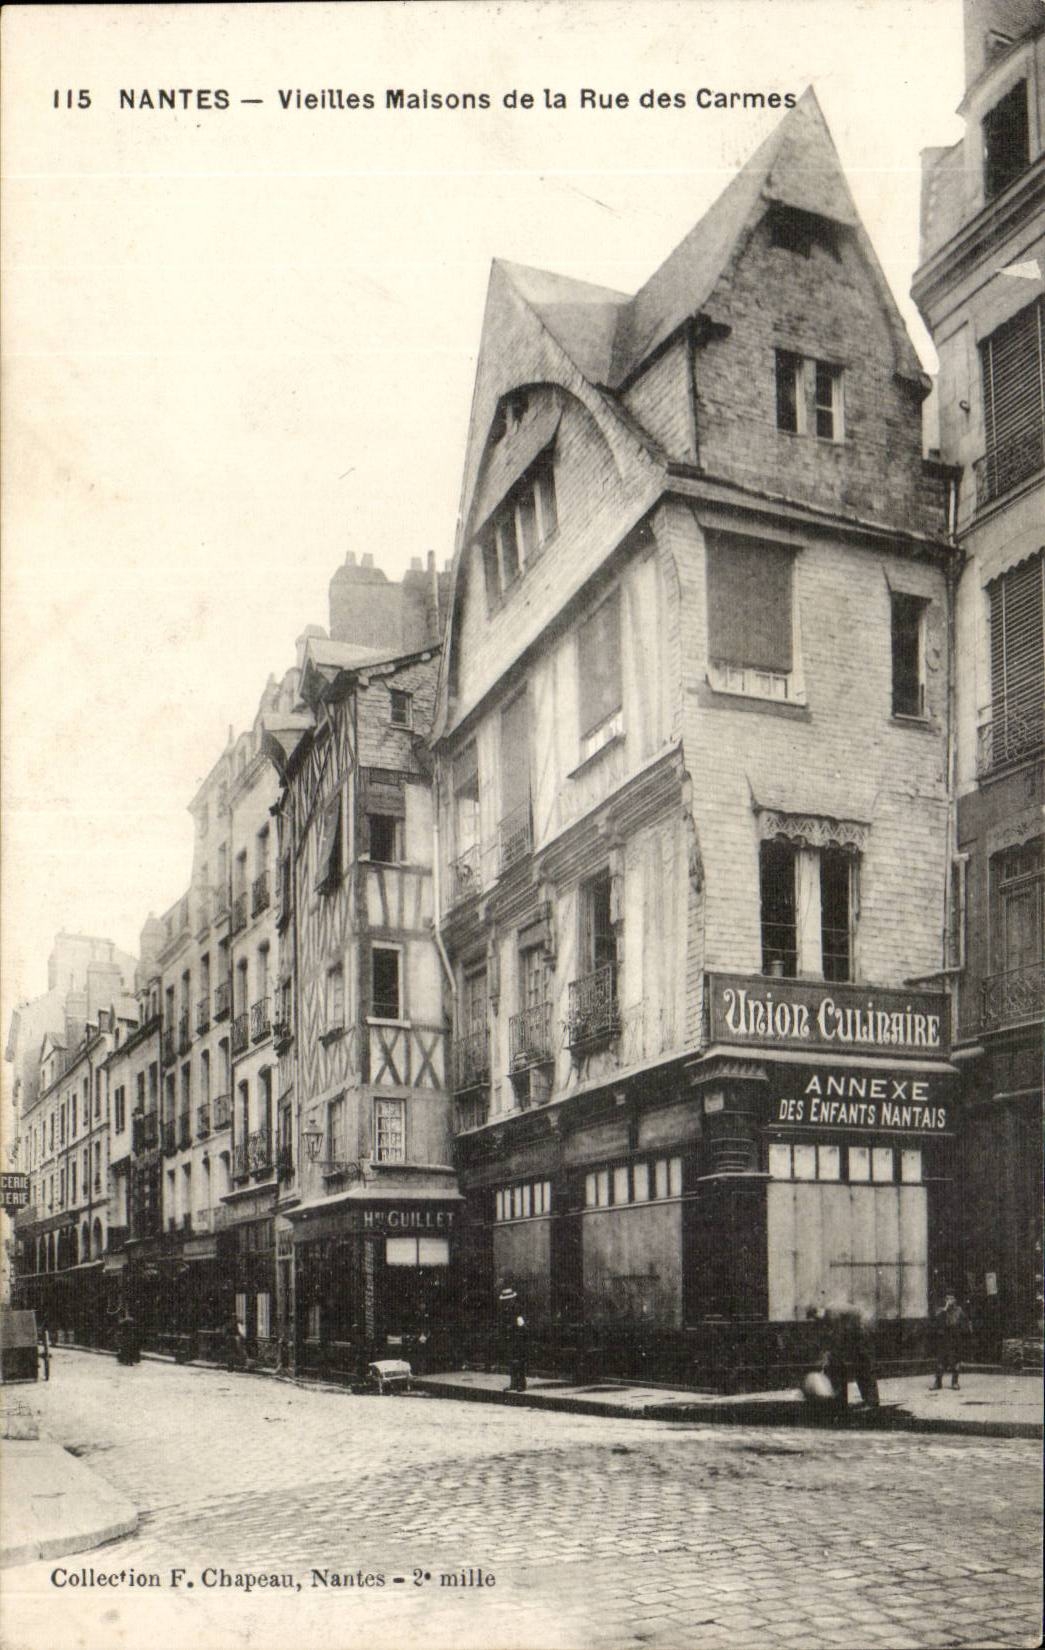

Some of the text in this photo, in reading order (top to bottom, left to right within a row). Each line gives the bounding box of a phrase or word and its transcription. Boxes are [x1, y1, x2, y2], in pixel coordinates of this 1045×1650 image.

[805, 1075, 929, 1100] ANNEXE
[779, 1099, 803, 1121] DES
[881, 1103, 946, 1128] NANTAIS
